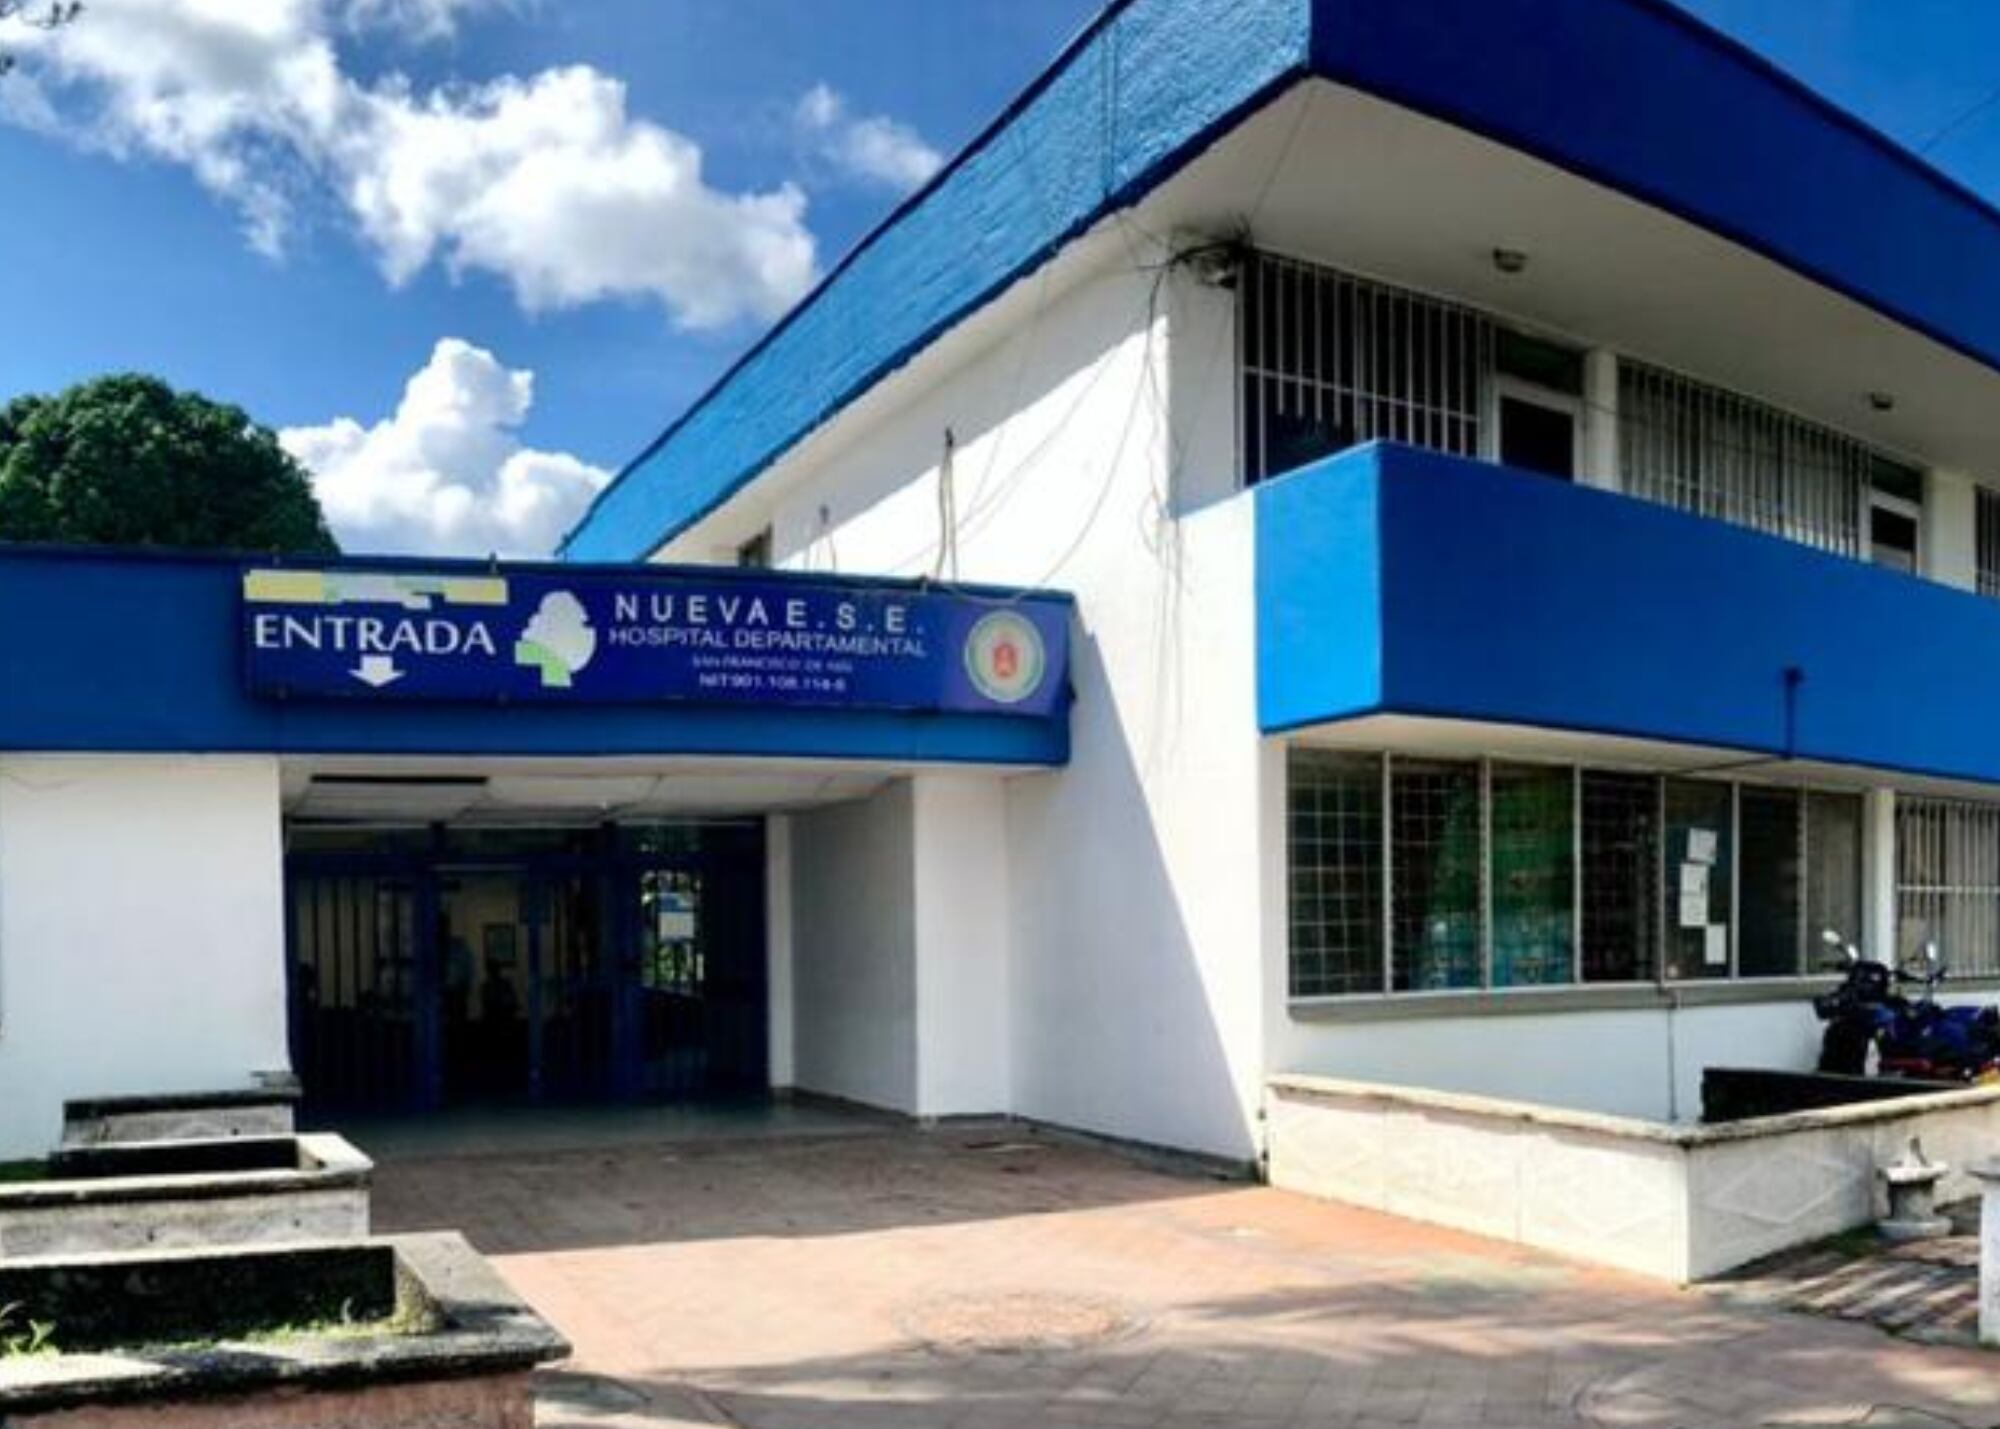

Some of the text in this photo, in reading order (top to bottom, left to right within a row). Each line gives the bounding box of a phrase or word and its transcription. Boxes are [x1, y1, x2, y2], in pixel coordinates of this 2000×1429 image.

[614, 593, 770, 626] NUEVA
[255, 613, 497, 656] ENTRADA
[608, 626, 927, 657] HOSPITAL DEPARTAMENTAL
